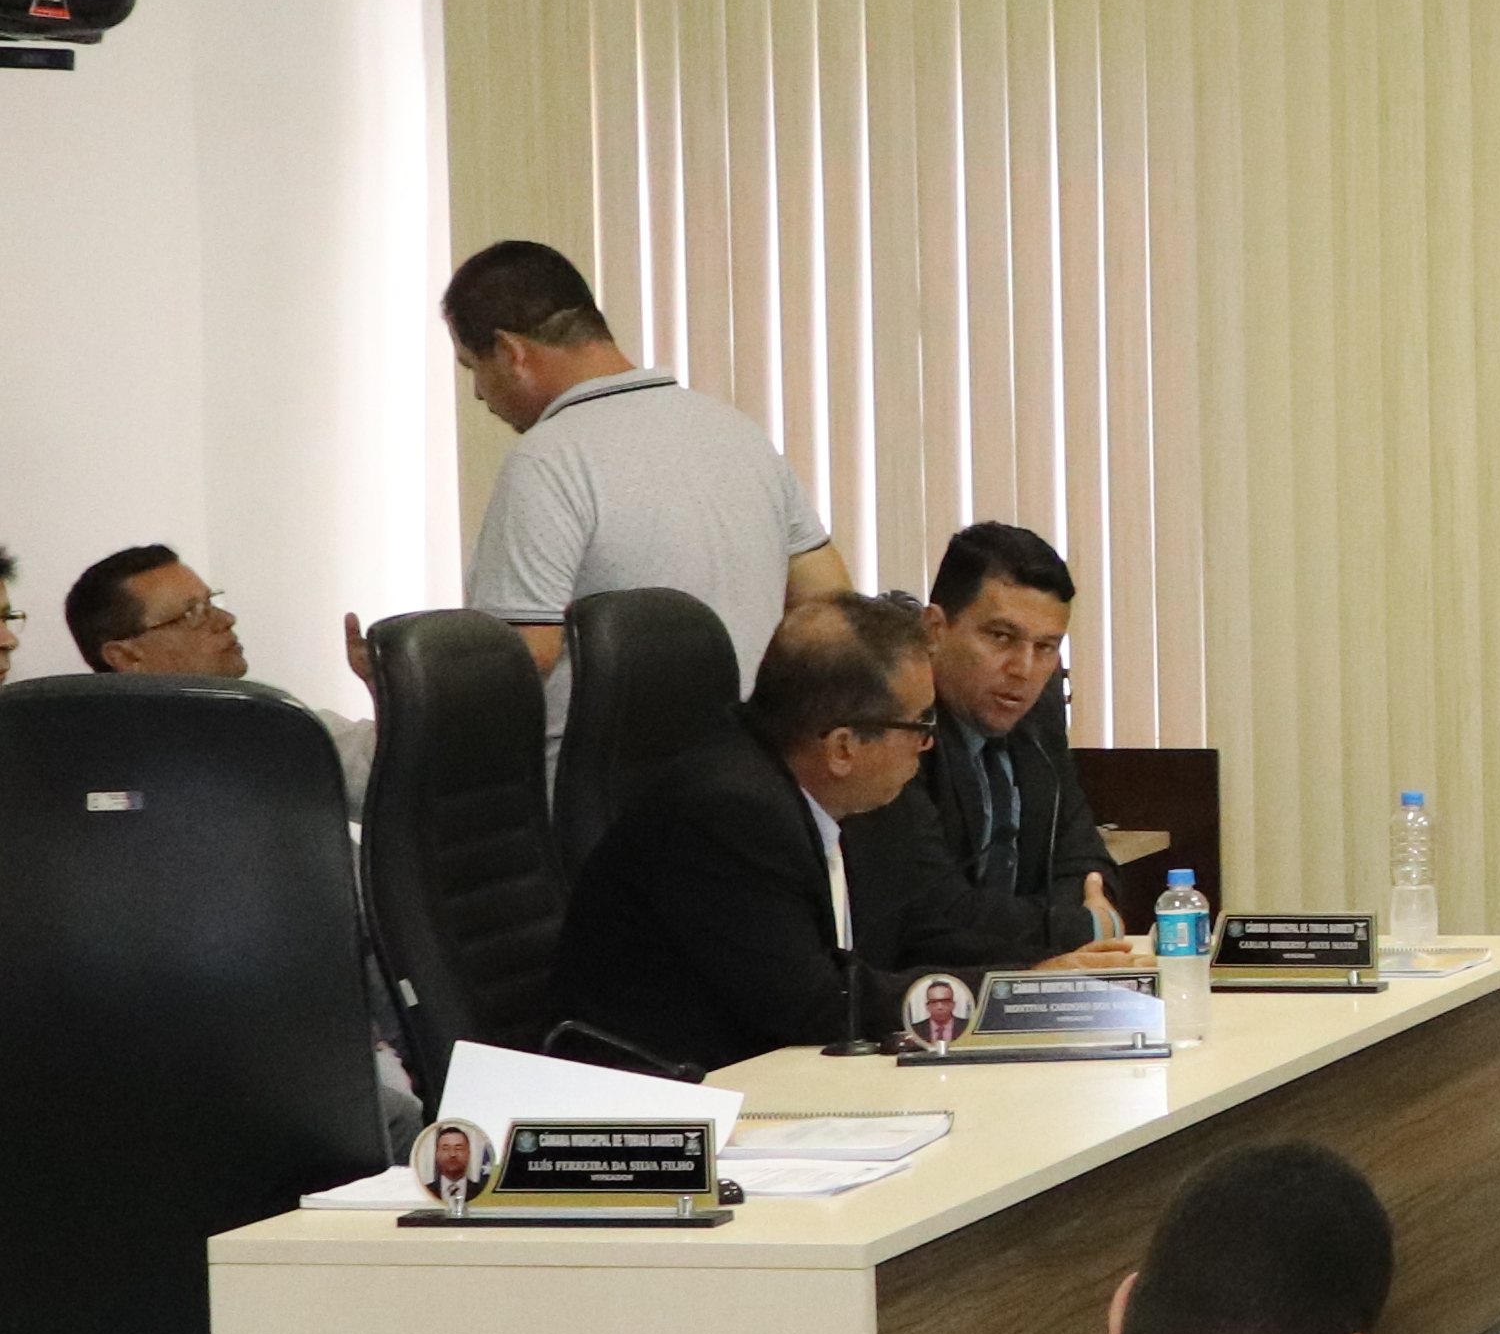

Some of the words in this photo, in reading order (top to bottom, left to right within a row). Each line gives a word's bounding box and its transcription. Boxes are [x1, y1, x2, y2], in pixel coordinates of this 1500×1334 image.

[555, 1160, 609, 1171] FERREIRA
[611, 1161, 628, 1171] DA
[629, 1161, 660, 1171] SILVA
[661, 1160, 695, 1171] FILHO
